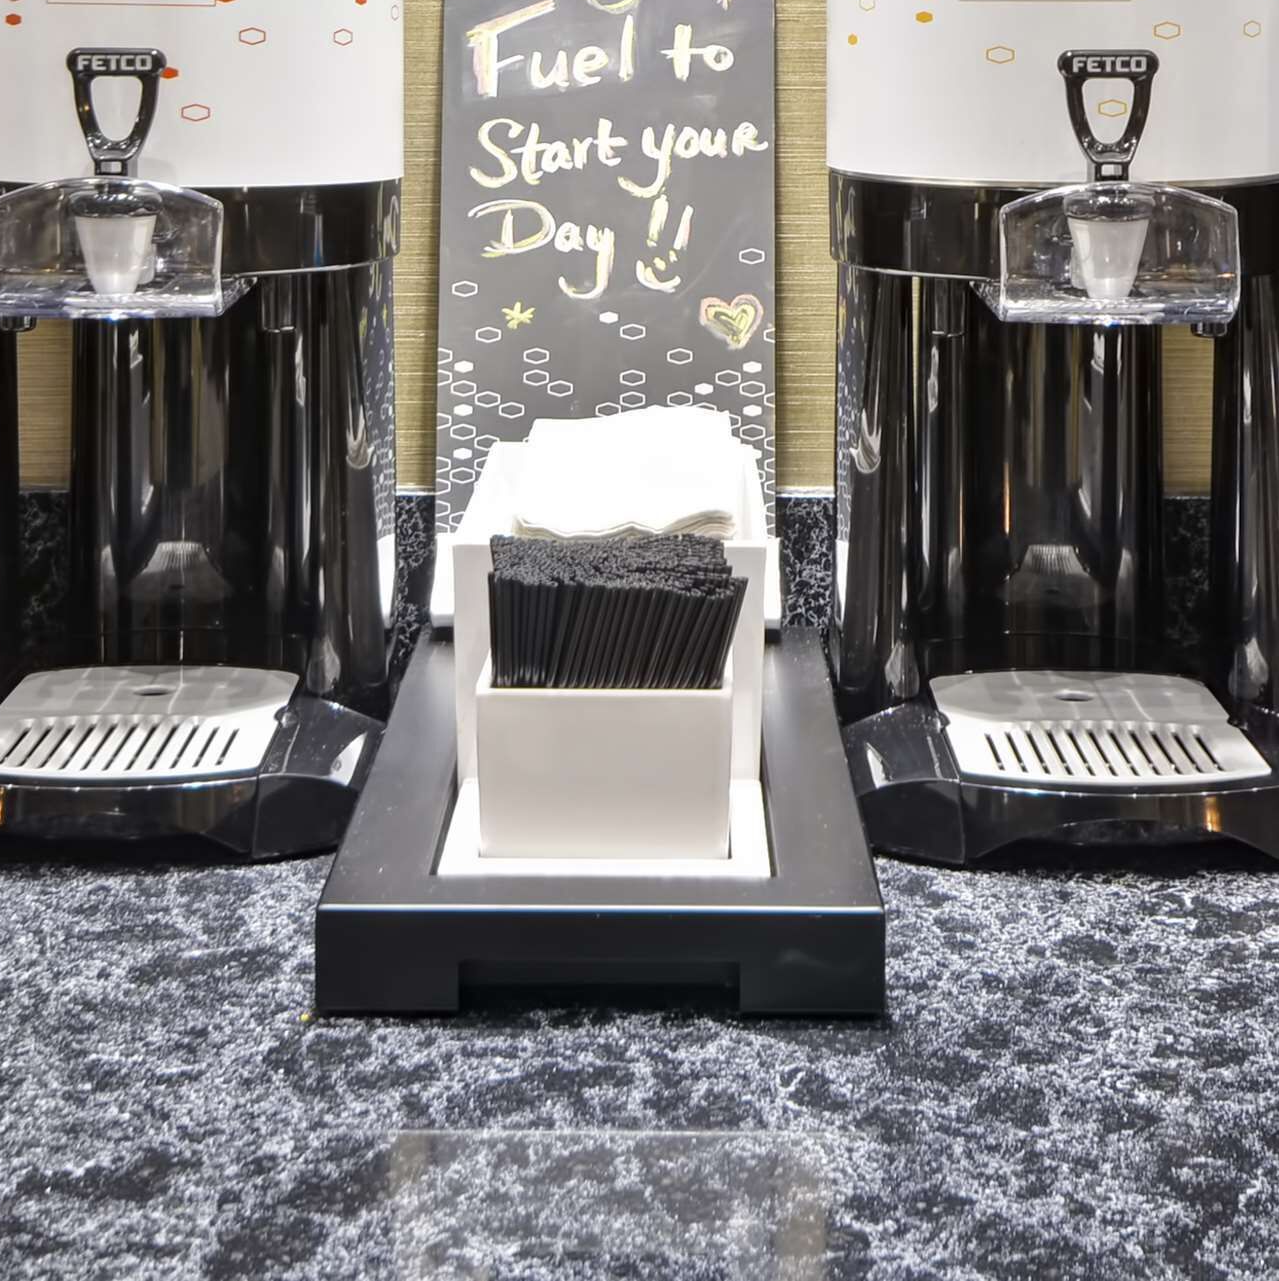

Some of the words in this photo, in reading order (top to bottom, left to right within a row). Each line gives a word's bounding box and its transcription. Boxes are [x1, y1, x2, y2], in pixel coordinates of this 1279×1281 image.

[77, 54, 153, 71] FETCO
[661, 22, 735, 81] to
[1073, 56, 1148, 73] FETCO
[469, 117, 627, 189] Start
